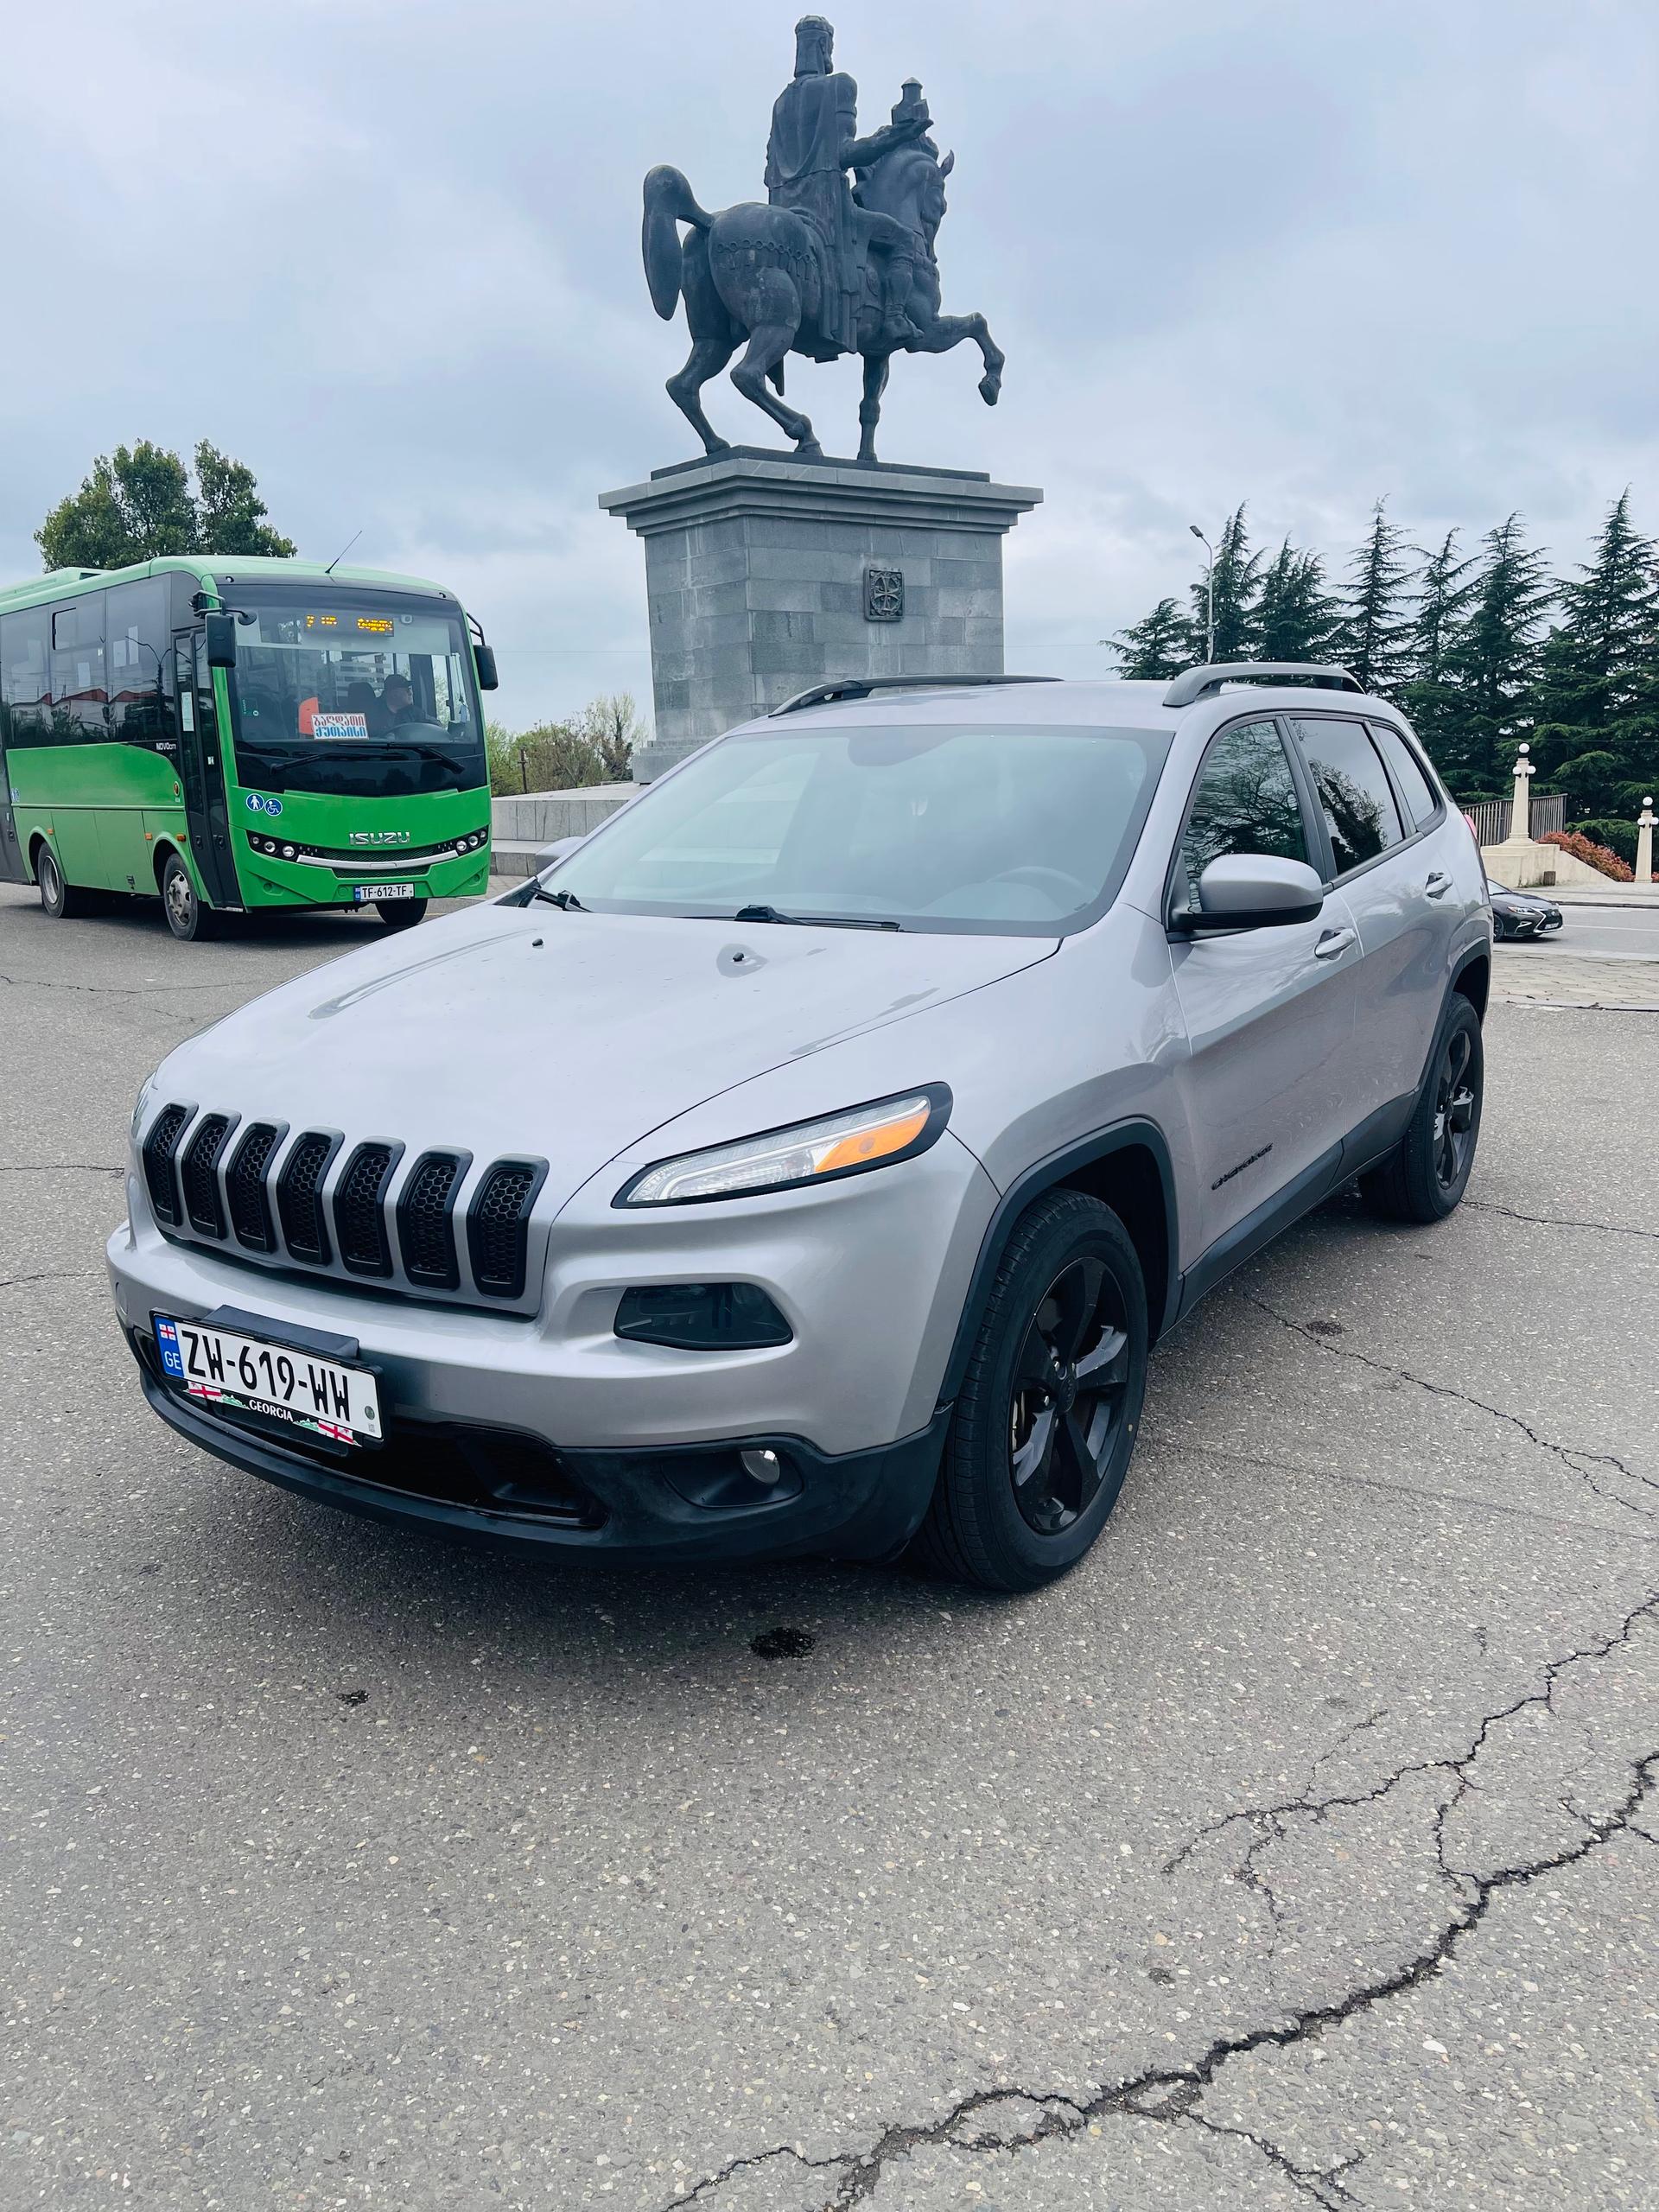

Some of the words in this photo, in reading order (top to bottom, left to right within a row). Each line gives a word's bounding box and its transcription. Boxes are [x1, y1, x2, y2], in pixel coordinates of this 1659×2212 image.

[315, 727, 366, 737] ქუთაისი
[349, 832, 410, 845] ISUZU
[362, 886, 407, 898] TF-612-TF
[164, 1351, 182, 1370] GE
[181, 1330, 351, 1421] ZW-619-WW
[248, 1399, 294, 1421] GEORGIA
